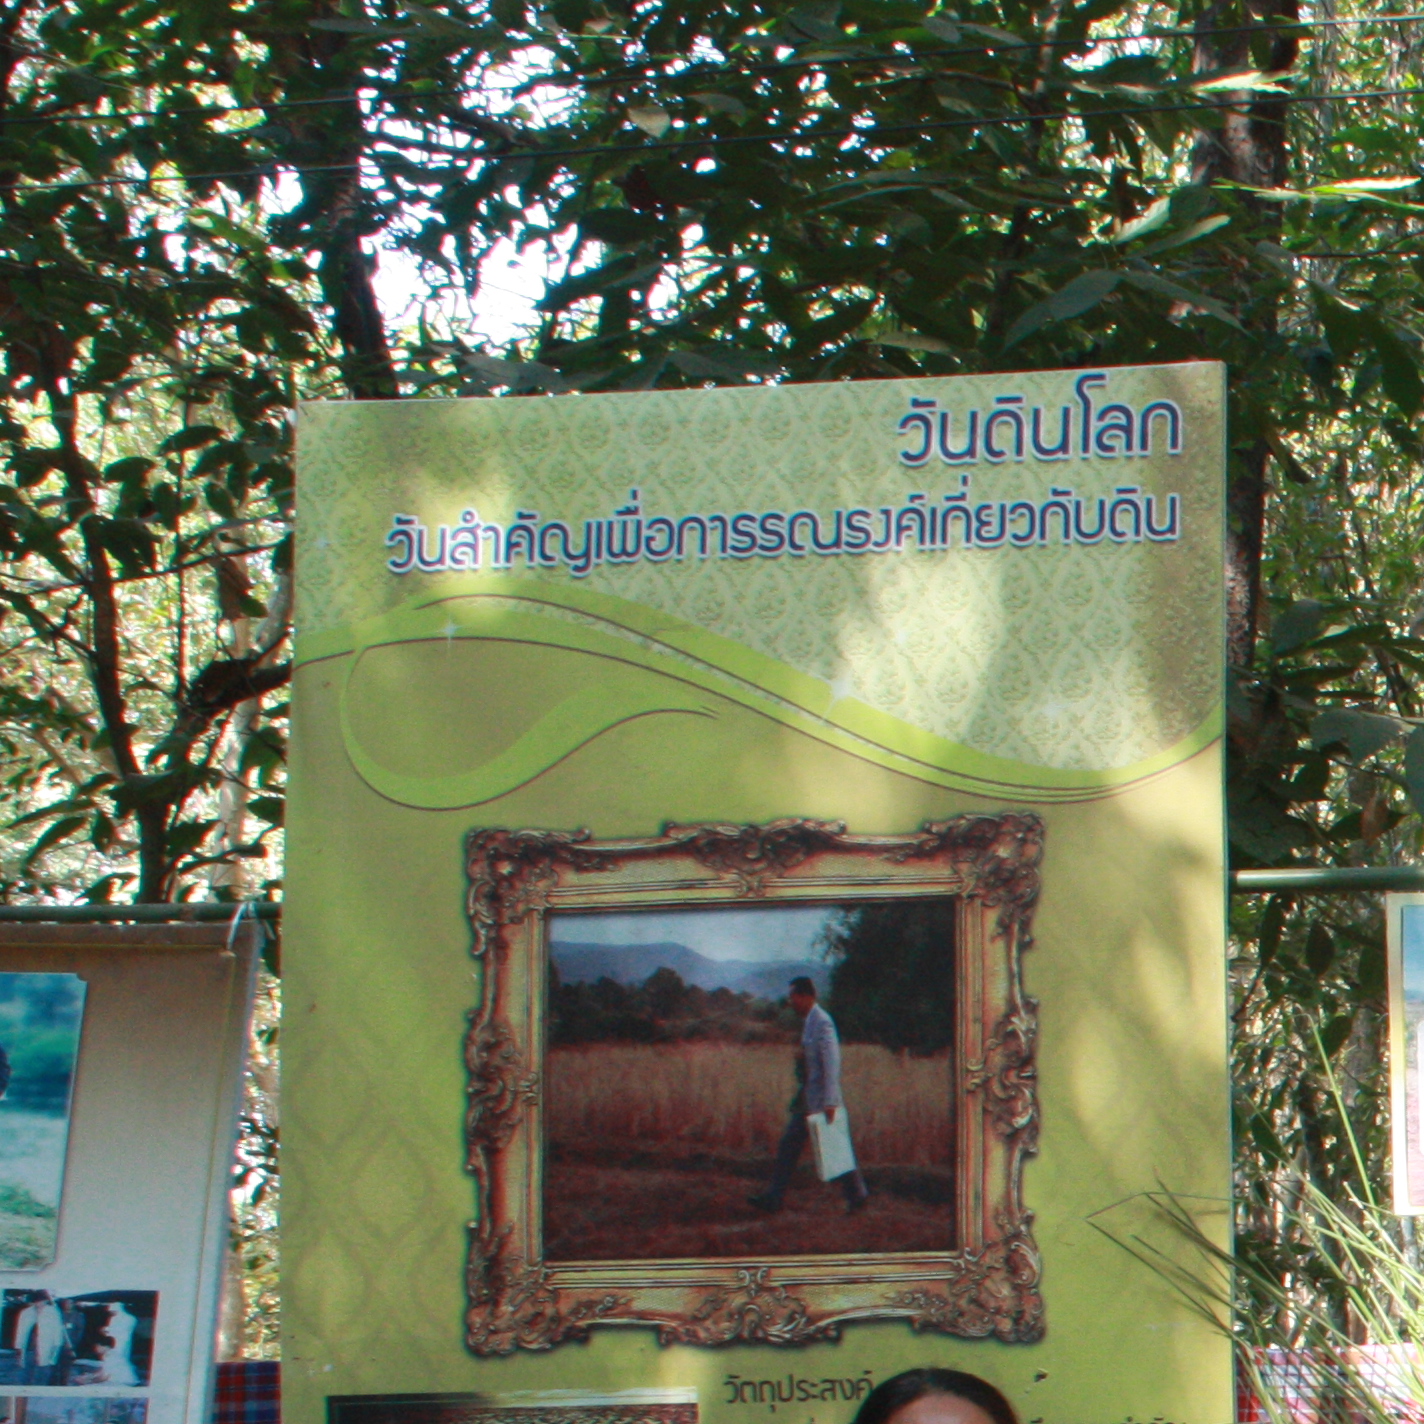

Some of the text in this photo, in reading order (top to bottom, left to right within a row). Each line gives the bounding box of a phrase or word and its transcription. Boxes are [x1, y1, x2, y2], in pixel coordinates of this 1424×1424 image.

[899, 374, 1182, 465] วันดินโลก
[387, 475, 1179, 576] วันสำคัญเพื่อการรณรงค์เกี่ยวกับดิน
[723, 1370, 875, 1413] วัตถุประสงค์
